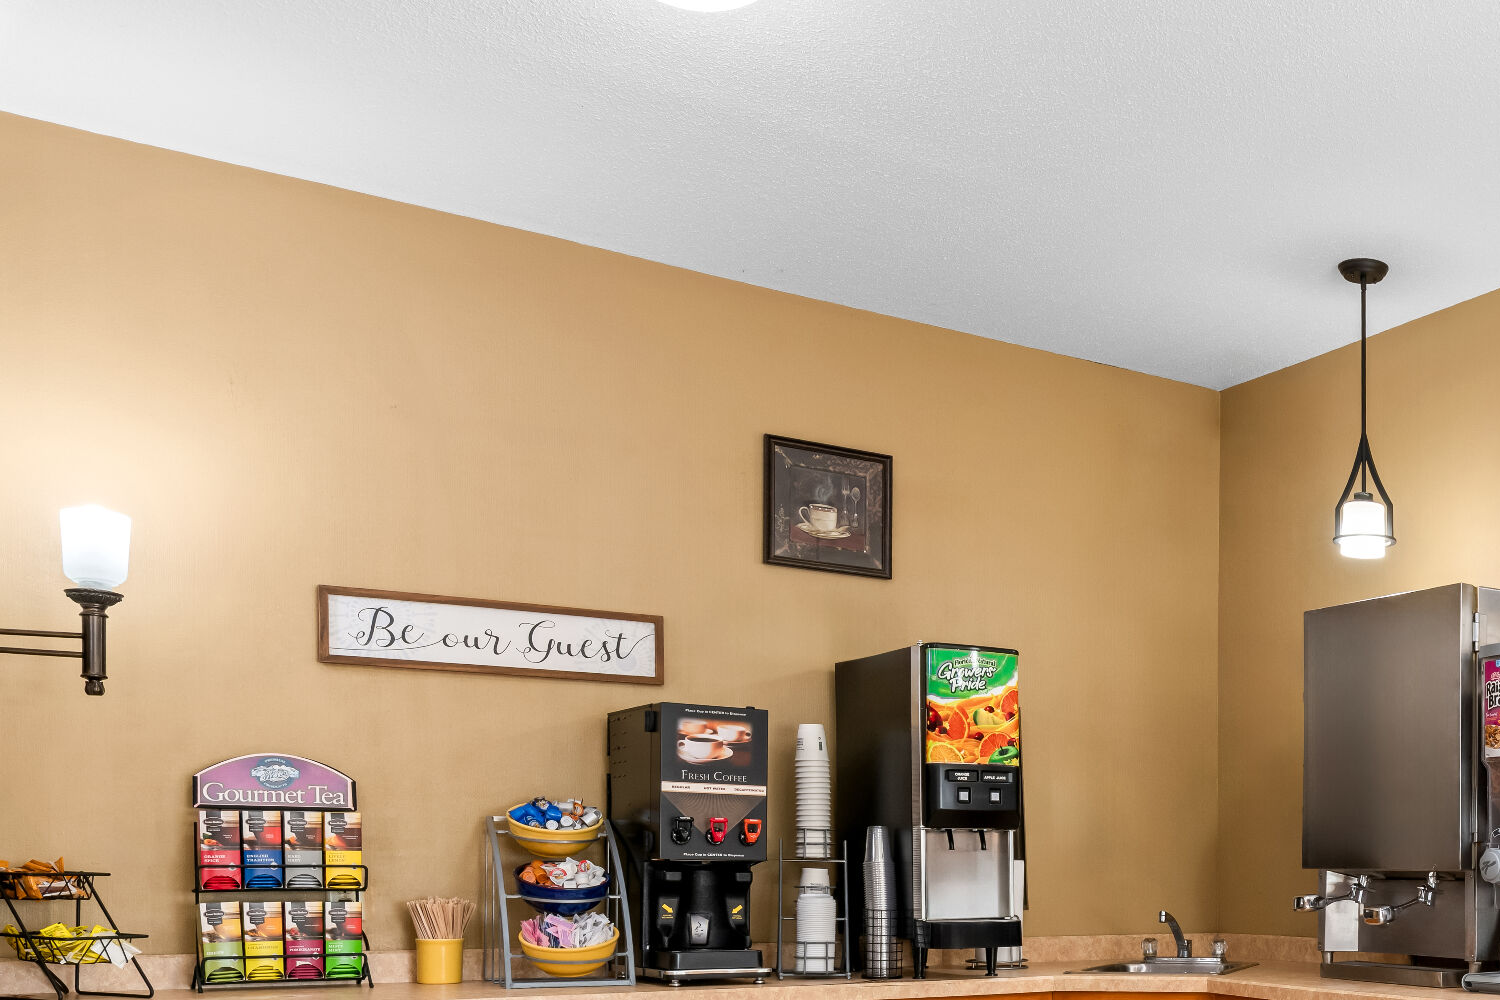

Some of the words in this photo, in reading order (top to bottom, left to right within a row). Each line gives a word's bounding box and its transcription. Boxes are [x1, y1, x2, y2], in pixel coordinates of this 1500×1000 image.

[347, 605, 425, 649] Be
[438, 627, 512, 656] our
[516, 619, 654, 665] Guest
[949, 677, 987, 693] Pride
[681, 769, 710, 781] FRESH
[713, 771, 747, 783] COFFEE
[202, 782, 306, 804] Gourmet
[308, 785, 346, 805] Tea
